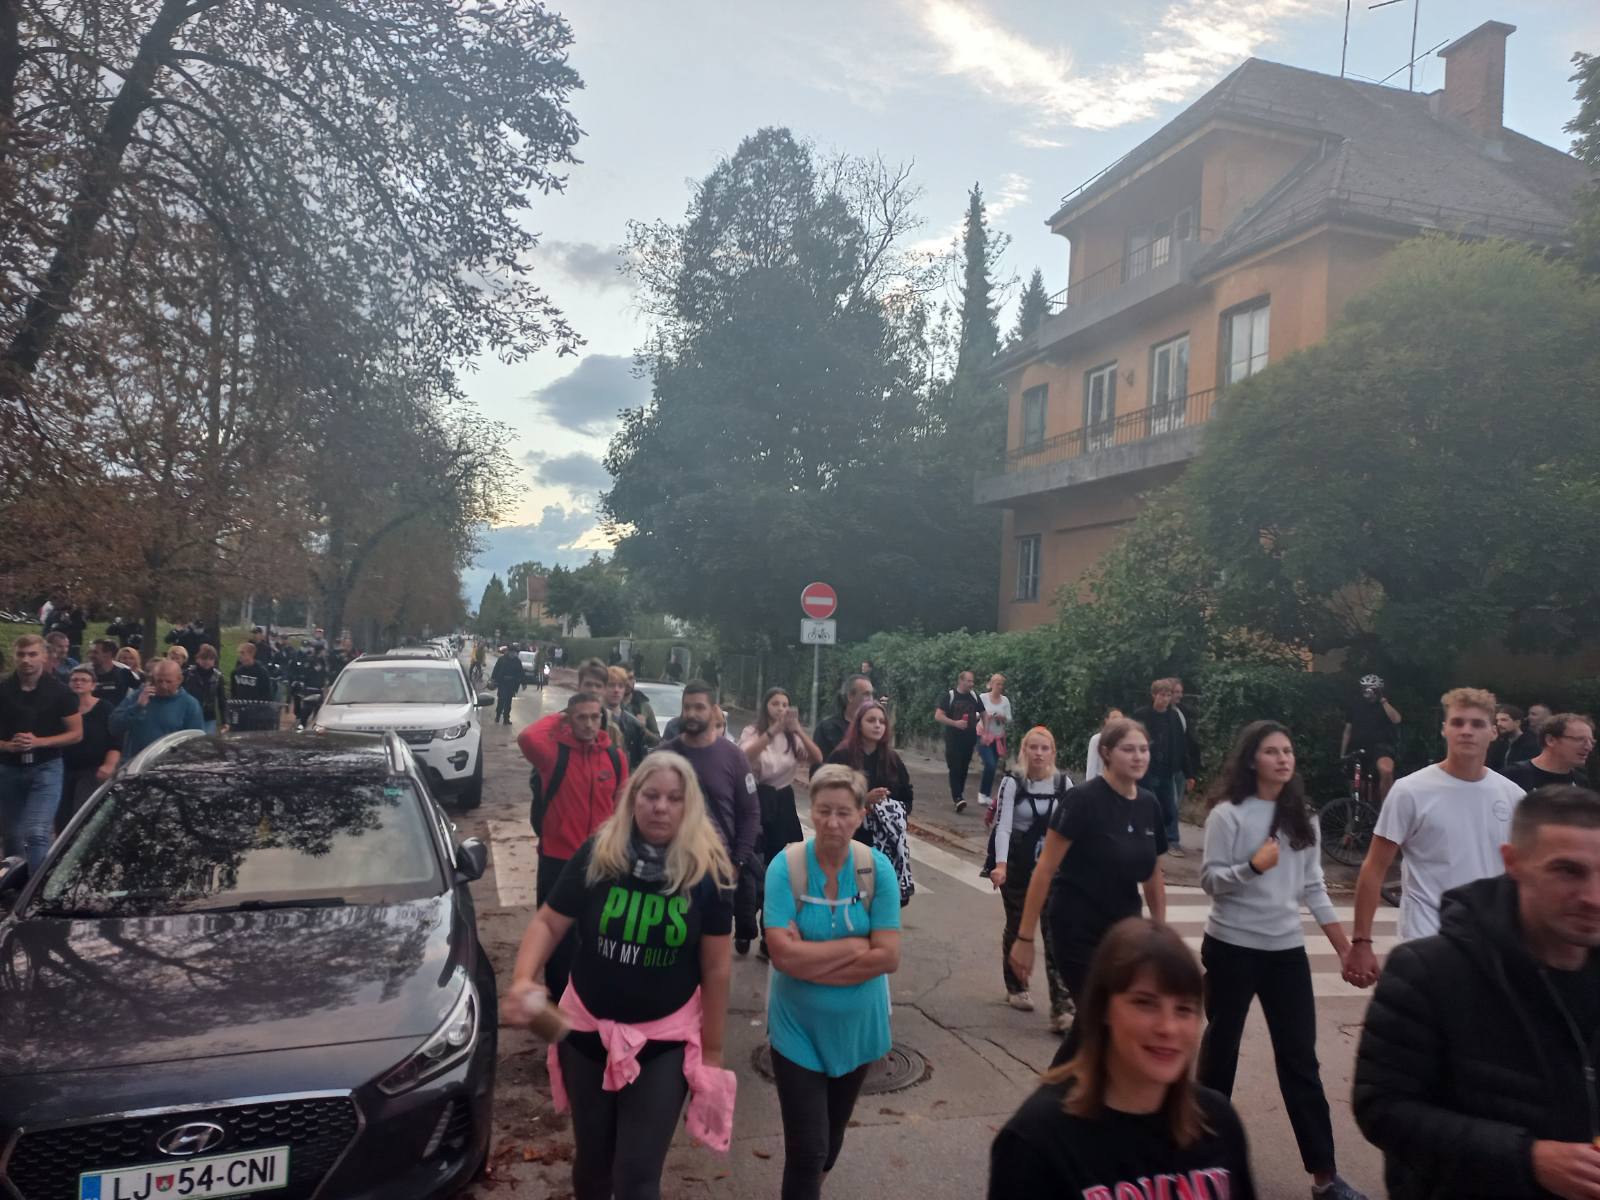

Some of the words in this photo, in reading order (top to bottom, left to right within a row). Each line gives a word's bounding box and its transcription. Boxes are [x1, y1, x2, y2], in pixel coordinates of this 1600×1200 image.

[599, 886, 689, 947] PIPS
[598, 936, 617, 959] PAY
[619, 943, 641, 966] MY
[643, 948, 679, 967] BILLS
[113, 1172, 152, 1200] LJ
[178, 1155, 276, 1195] 54-CNI
